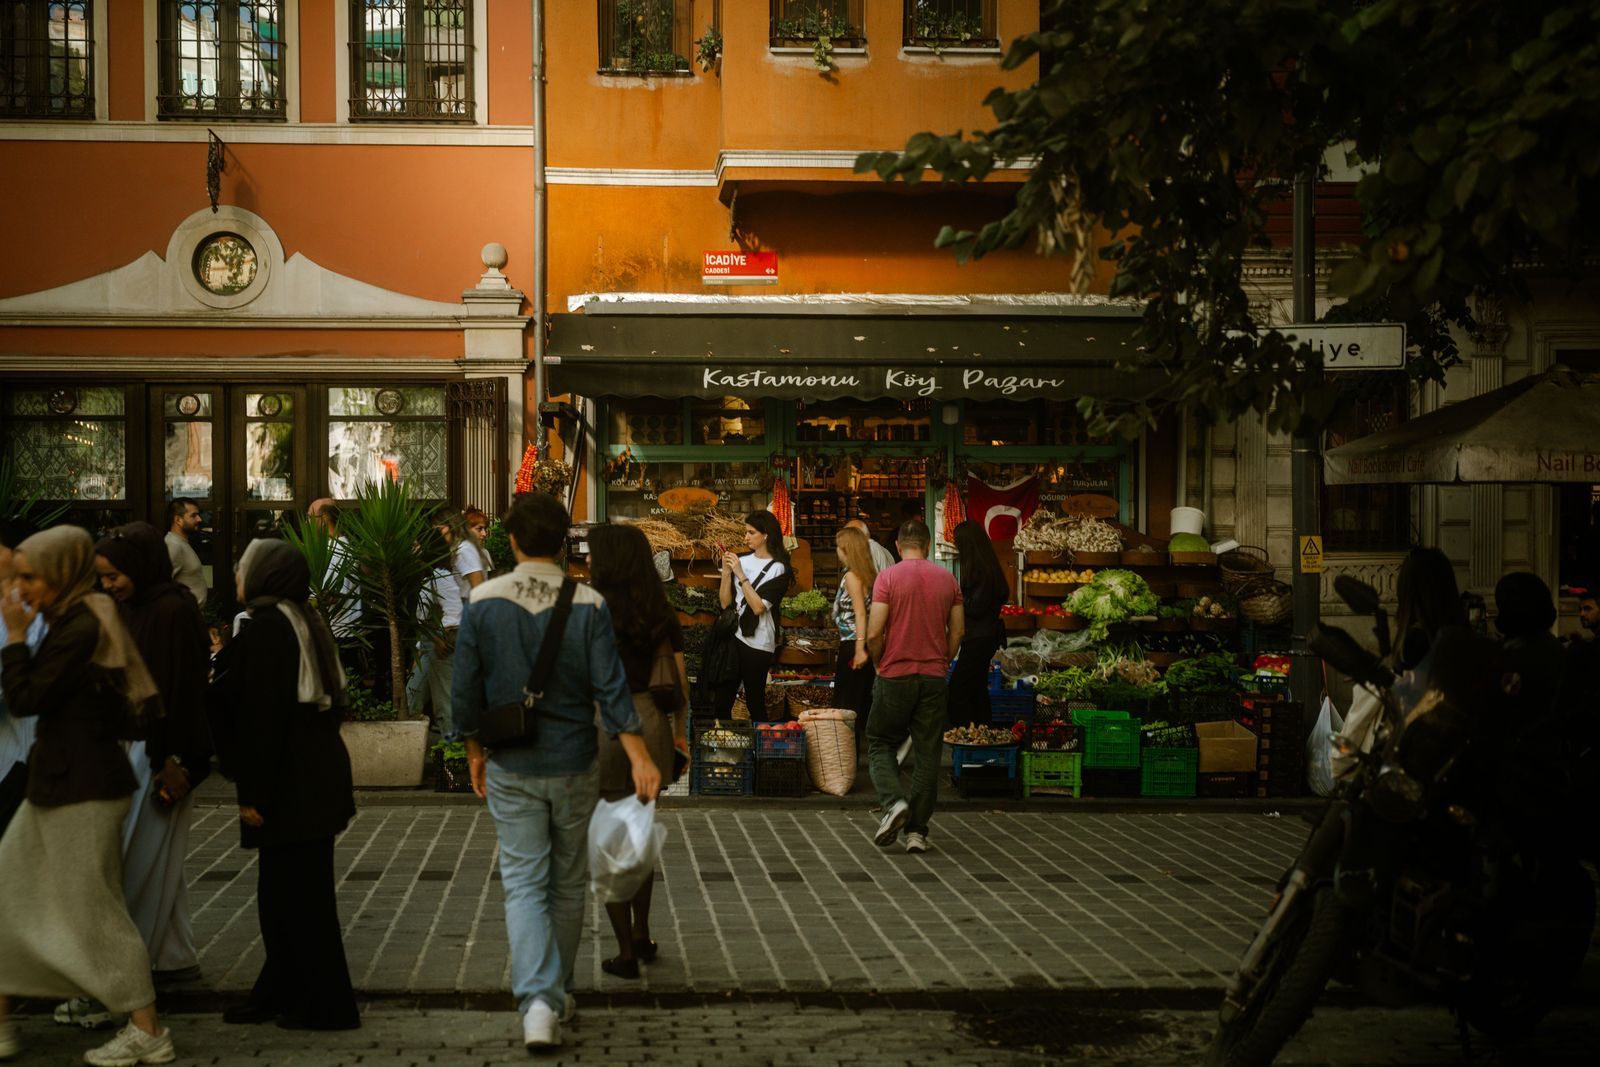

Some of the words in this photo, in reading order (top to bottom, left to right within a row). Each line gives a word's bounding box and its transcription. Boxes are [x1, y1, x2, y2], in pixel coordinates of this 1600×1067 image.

[705, 253, 747, 266] İCADİYE
[703, 367, 860, 389] Kastamonu
[885, 368, 943, 396] Köy
[1536, 453, 1575, 472] Nail
